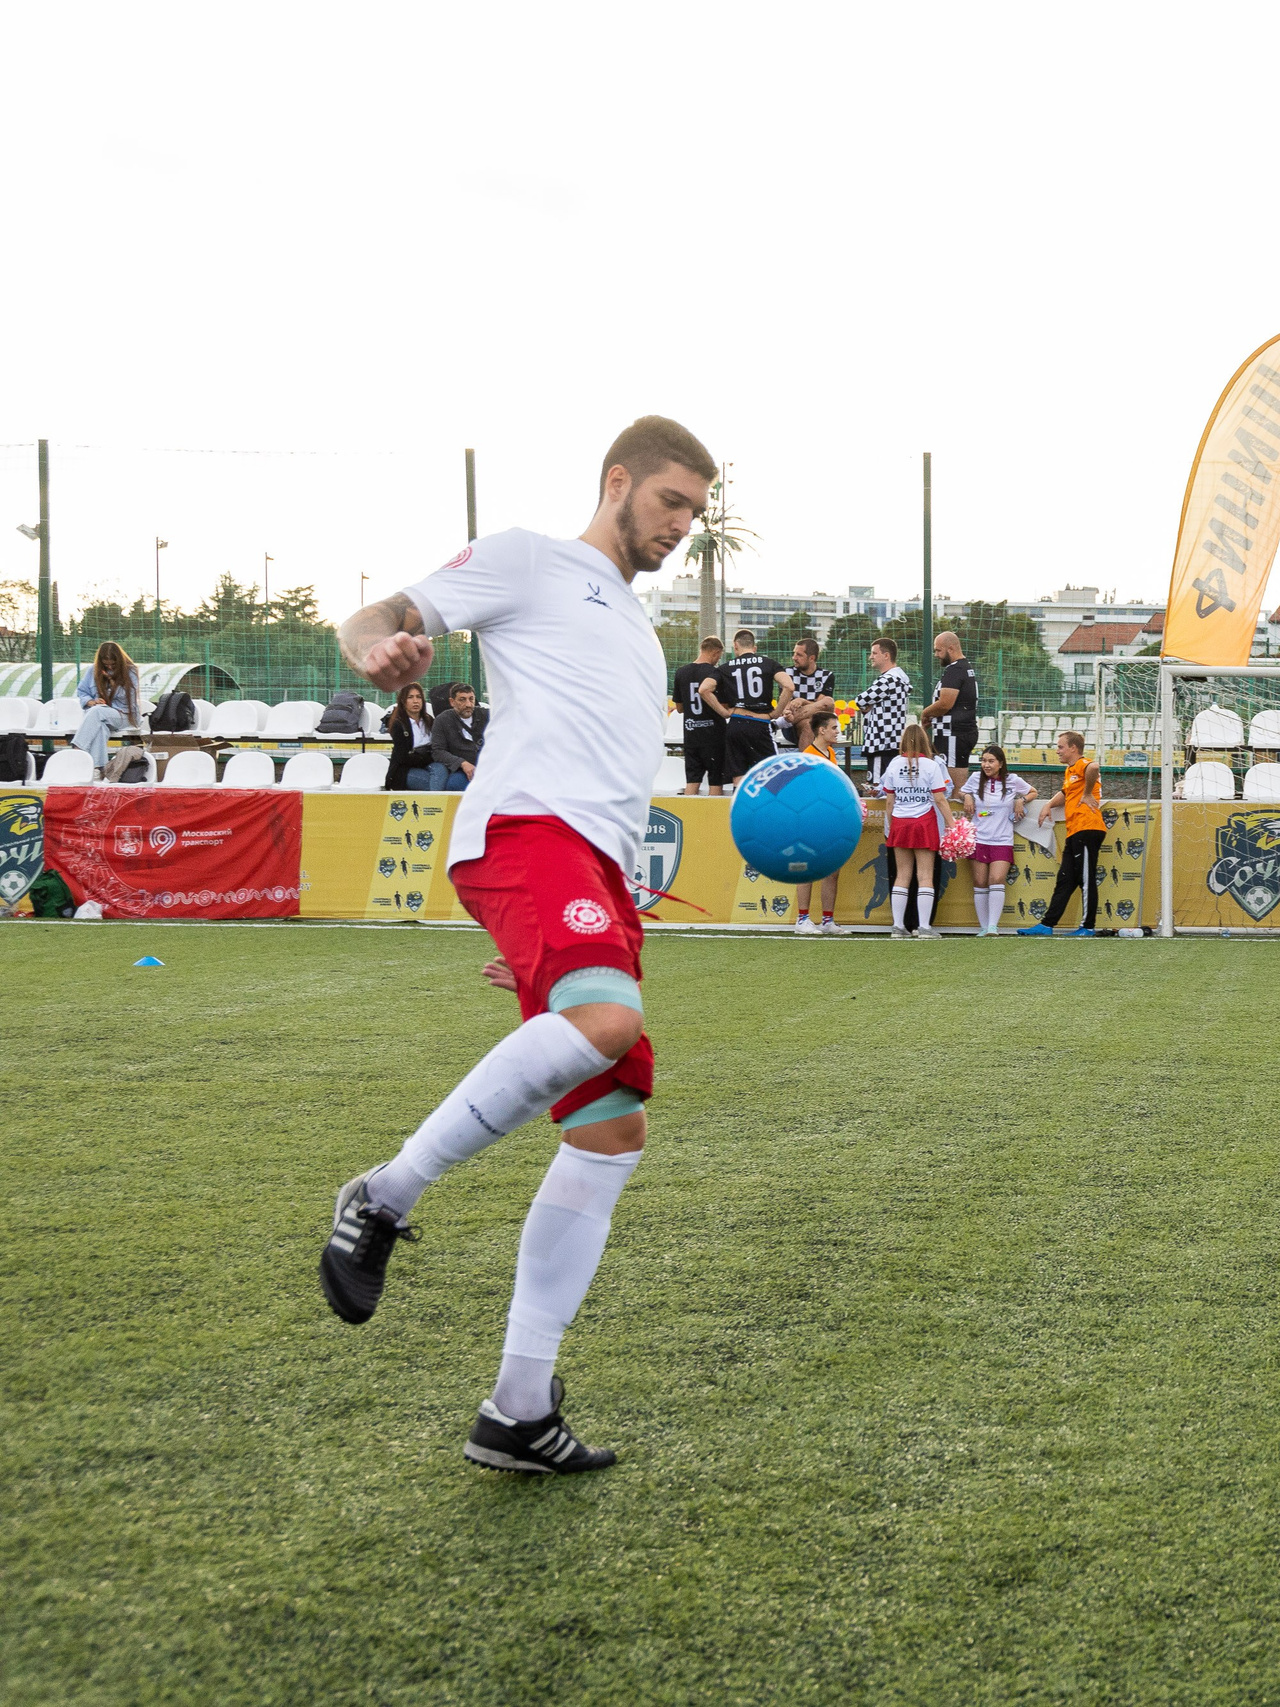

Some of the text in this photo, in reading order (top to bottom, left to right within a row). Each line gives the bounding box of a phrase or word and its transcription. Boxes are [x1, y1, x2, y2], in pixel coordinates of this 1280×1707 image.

[728, 656, 764, 667] МАРКОВ
[731, 666, 764, 700] 16
[689, 682, 703, 715] 5
[181, 828, 233, 837] Московский
[645, 824, 667, 834] 018
[181, 838, 224, 848] транспорт
